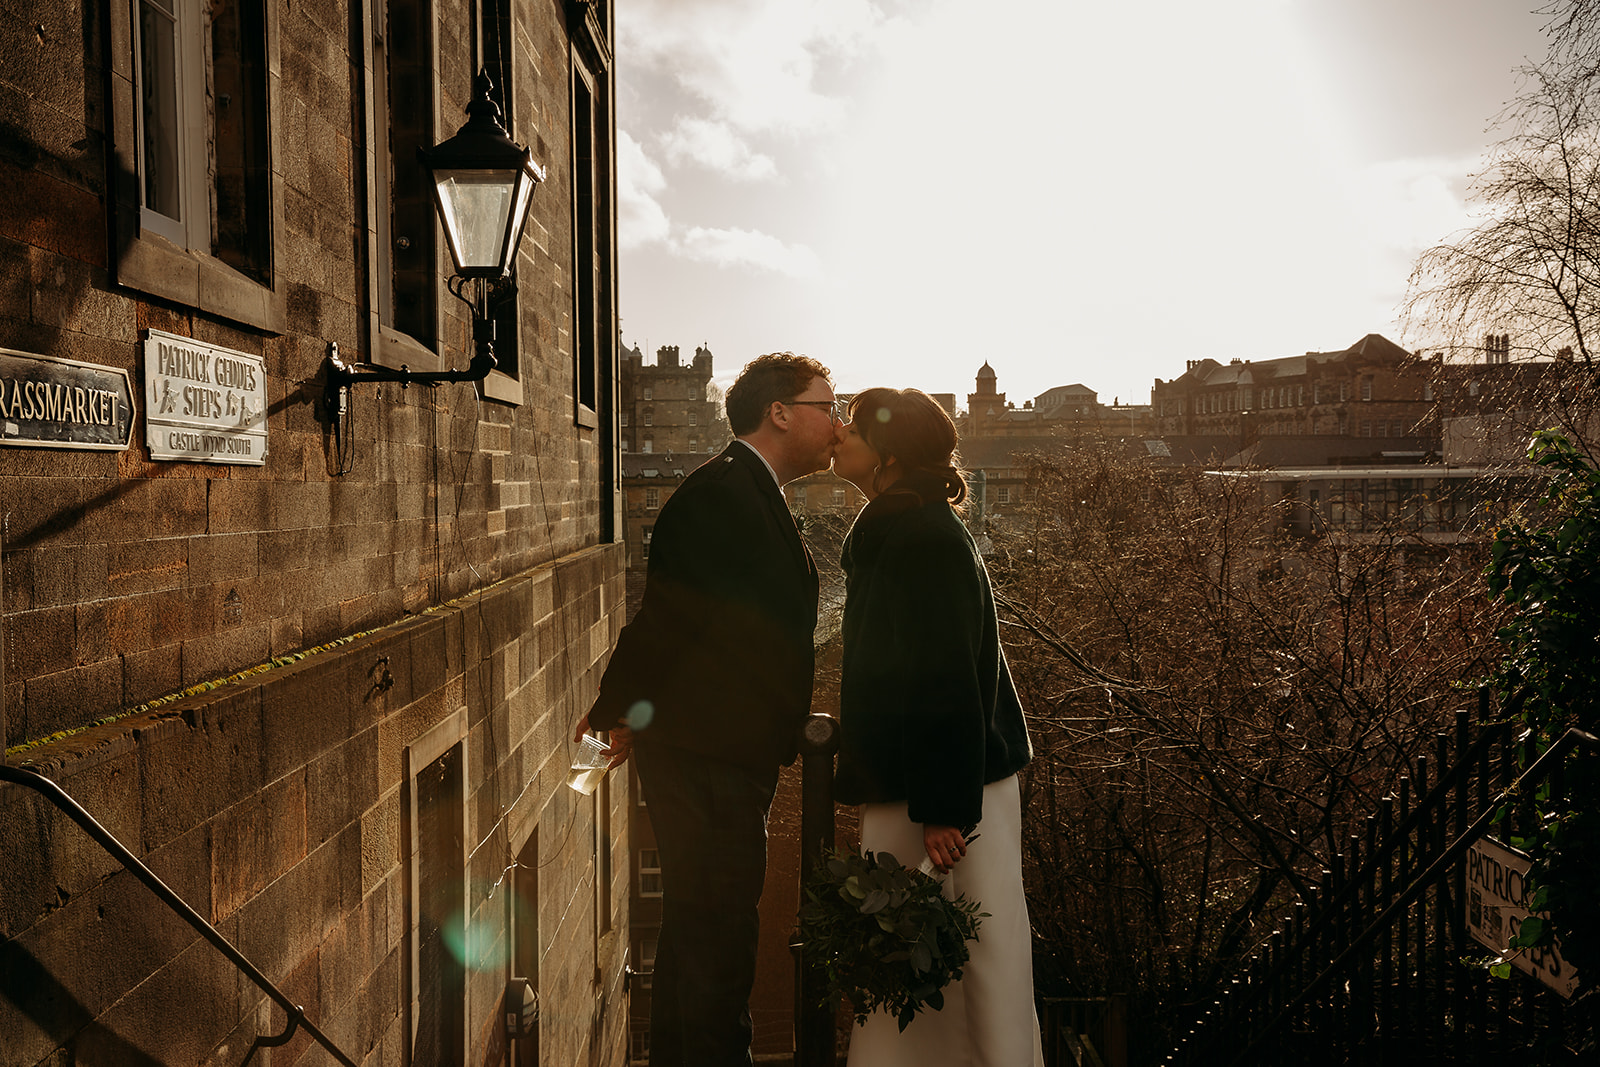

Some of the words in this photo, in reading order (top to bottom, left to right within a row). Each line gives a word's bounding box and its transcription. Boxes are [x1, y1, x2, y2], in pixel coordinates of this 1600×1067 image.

[158, 342, 212, 382] PATRICK
[214, 356, 257, 391] GEDDES
[183, 384, 222, 420] STEPS
[169, 431, 200, 452] CASTLE
[202, 434, 226, 454] WYND
[227, 437, 252, 455] SOUTH
